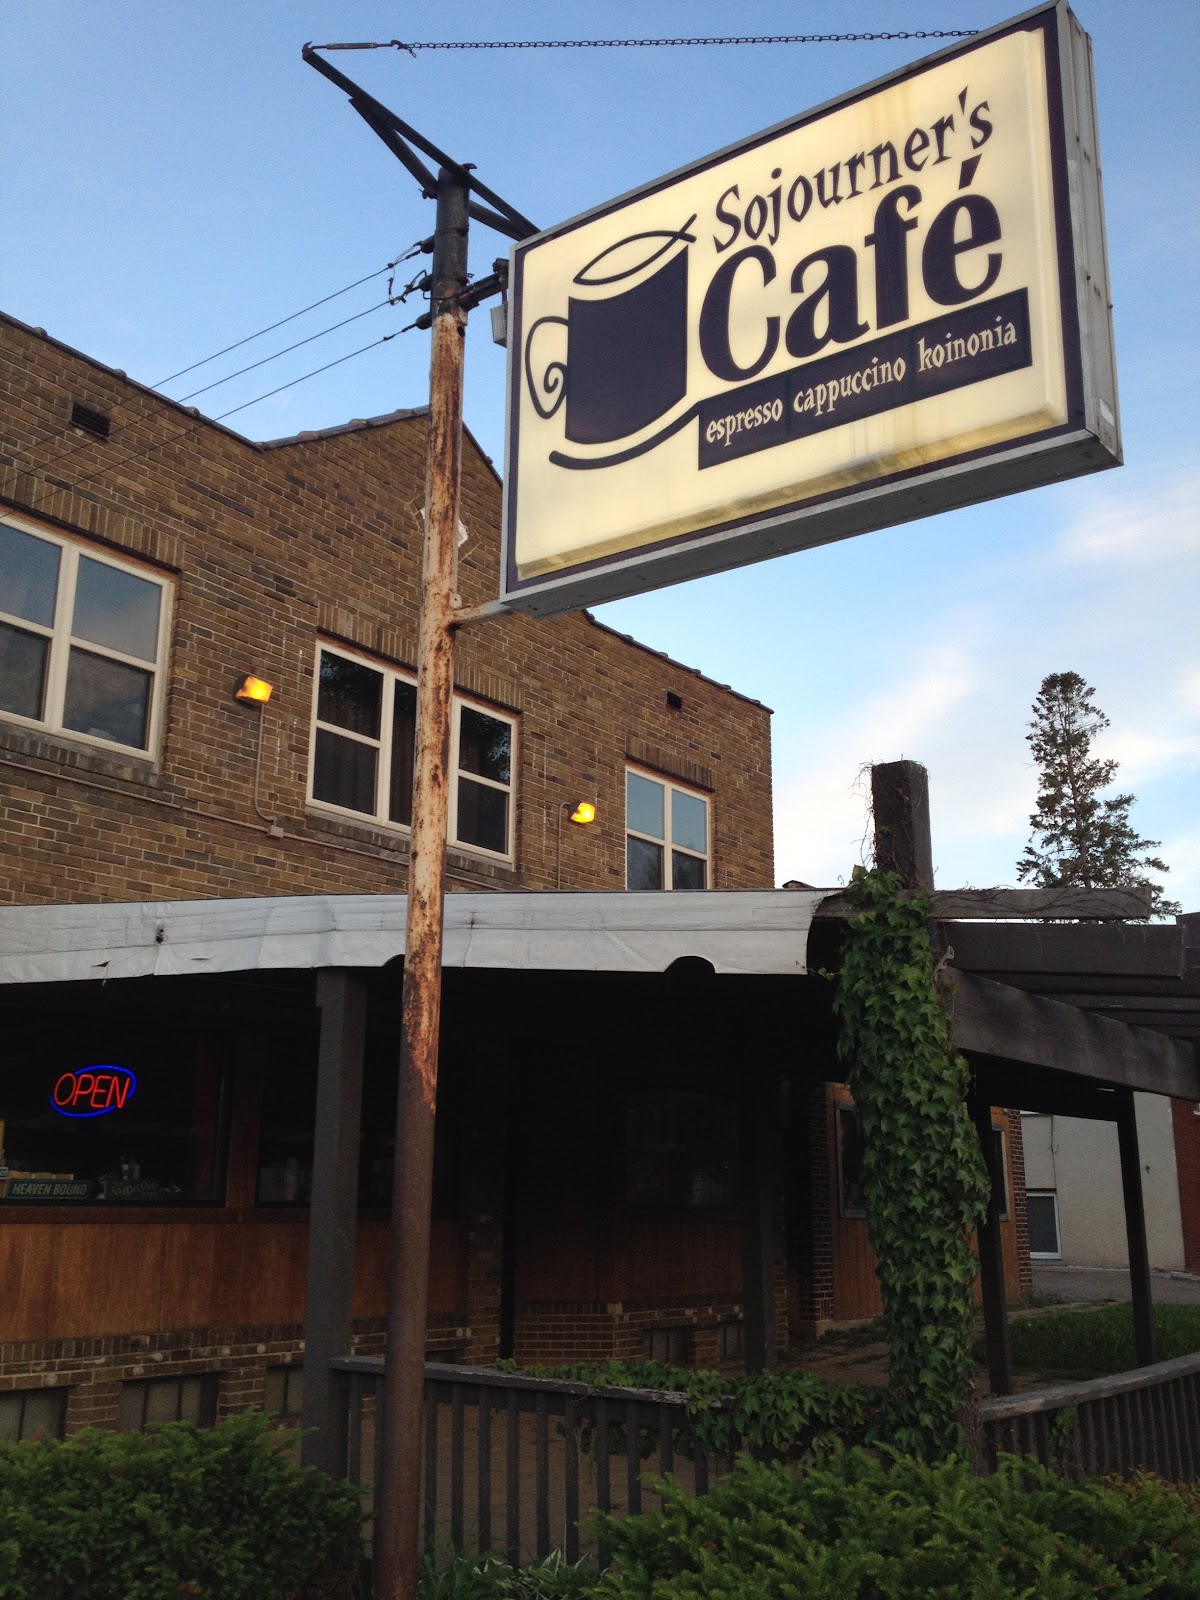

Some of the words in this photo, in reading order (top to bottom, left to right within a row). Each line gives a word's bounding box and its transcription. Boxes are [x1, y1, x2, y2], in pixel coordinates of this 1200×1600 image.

[713, 87, 993, 253] Sojourner's
[698, 155, 1003, 382] Café
[706, 399, 784, 446] espresso
[793, 357, 907, 417] cappuccino
[917, 316, 1018, 372] koinonia
[53, 1072, 131, 1109] OPEN
[12, 1183, 52, 1196] HEAVEN
[53, 1183, 88, 1196] BOUND
